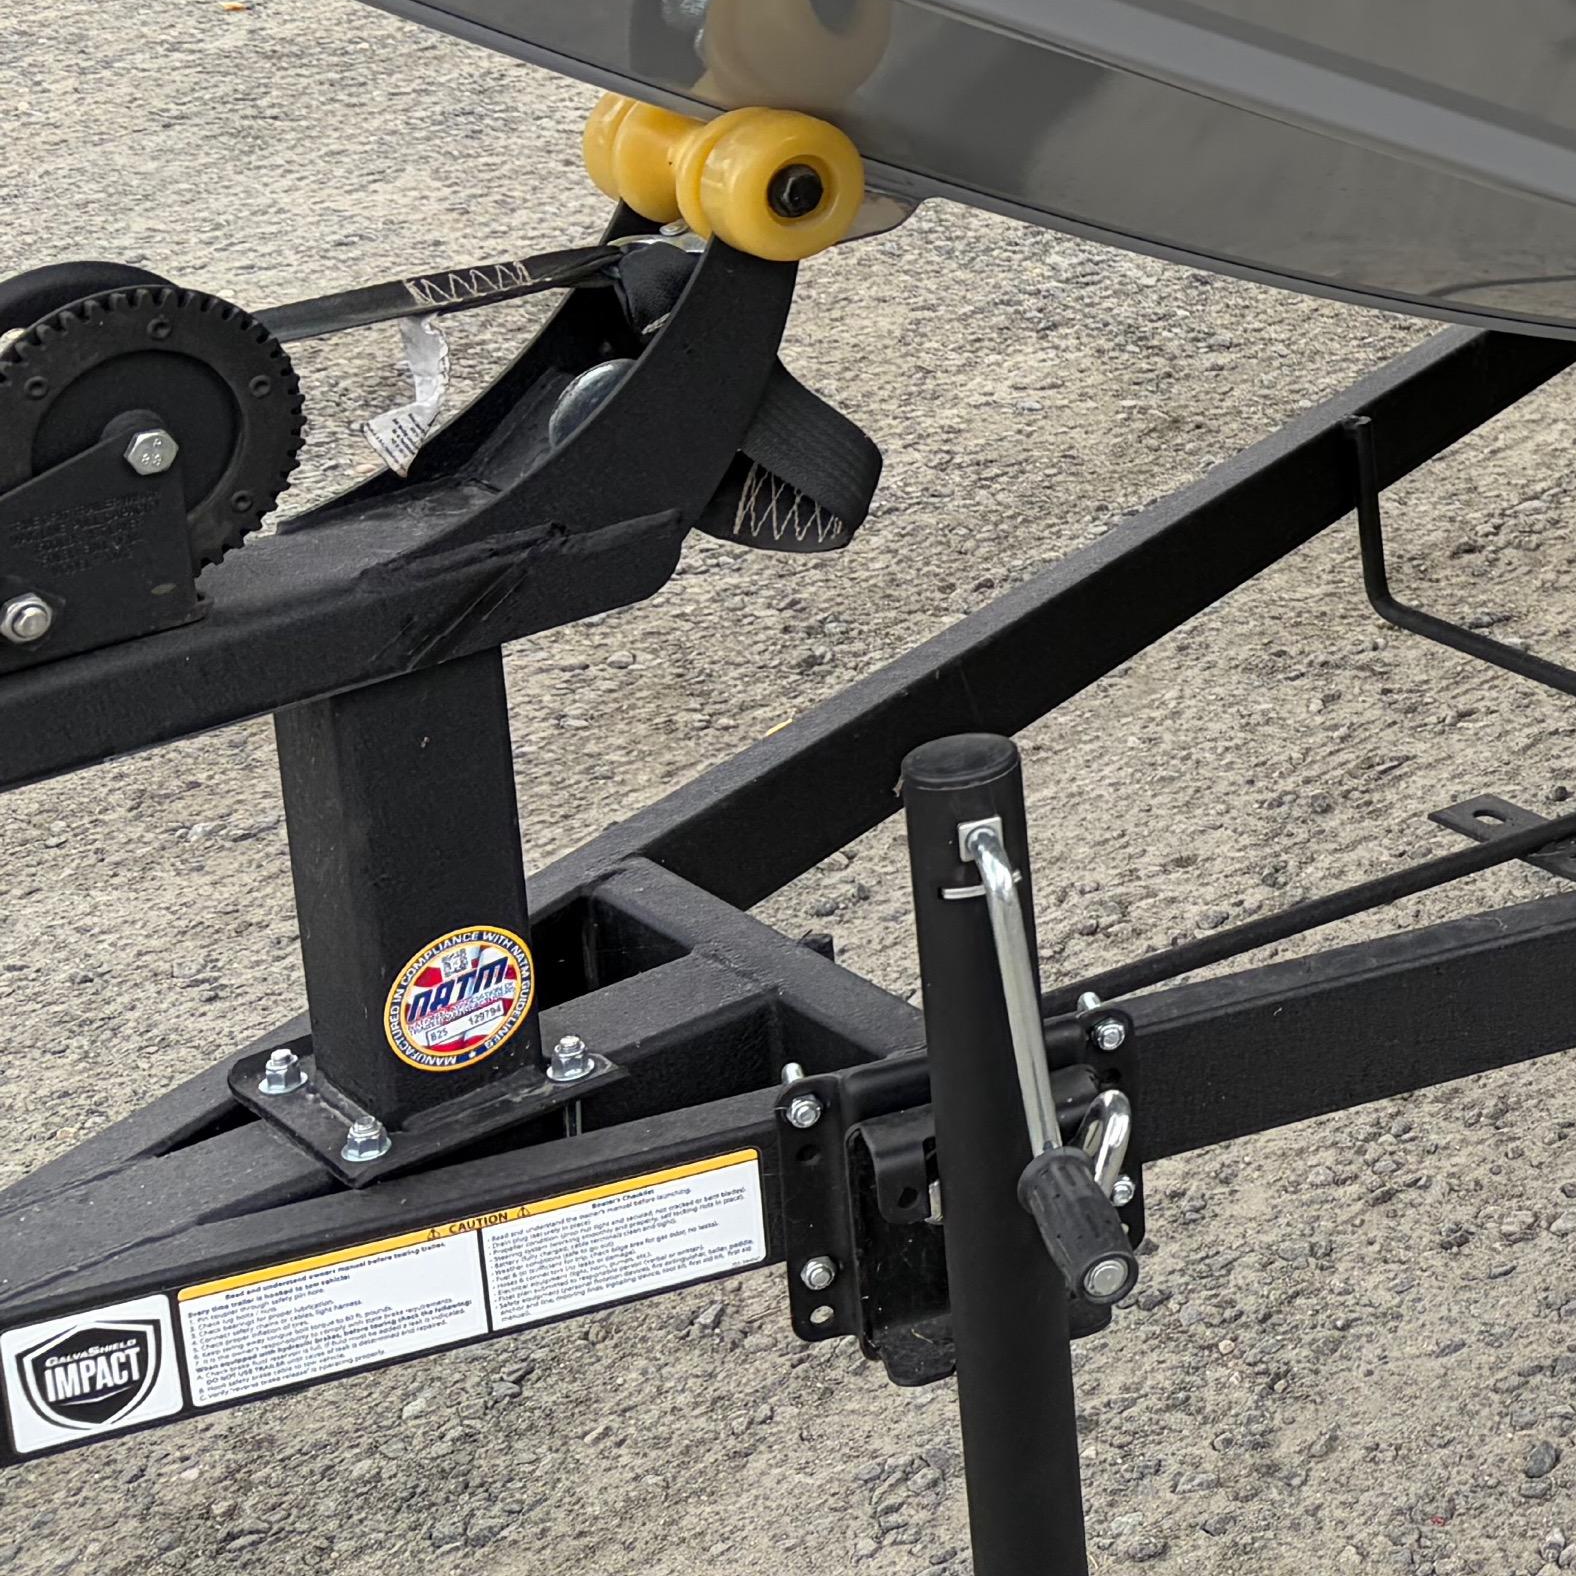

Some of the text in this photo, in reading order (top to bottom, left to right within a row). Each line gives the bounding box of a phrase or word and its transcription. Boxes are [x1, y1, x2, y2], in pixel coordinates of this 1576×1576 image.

[400, 931, 480, 986] COMPLIANCE
[482, 931, 513, 950] WITH
[511, 945, 531, 978] NATM
[392, 988, 403, 1003] IN
[407, 956, 509, 1023] NATM
[389, 1005, 457, 1066] MANUFACTURED
[449, 1211, 508, 1235] CAUTION
[44, 1348, 140, 1403] IMPACT
